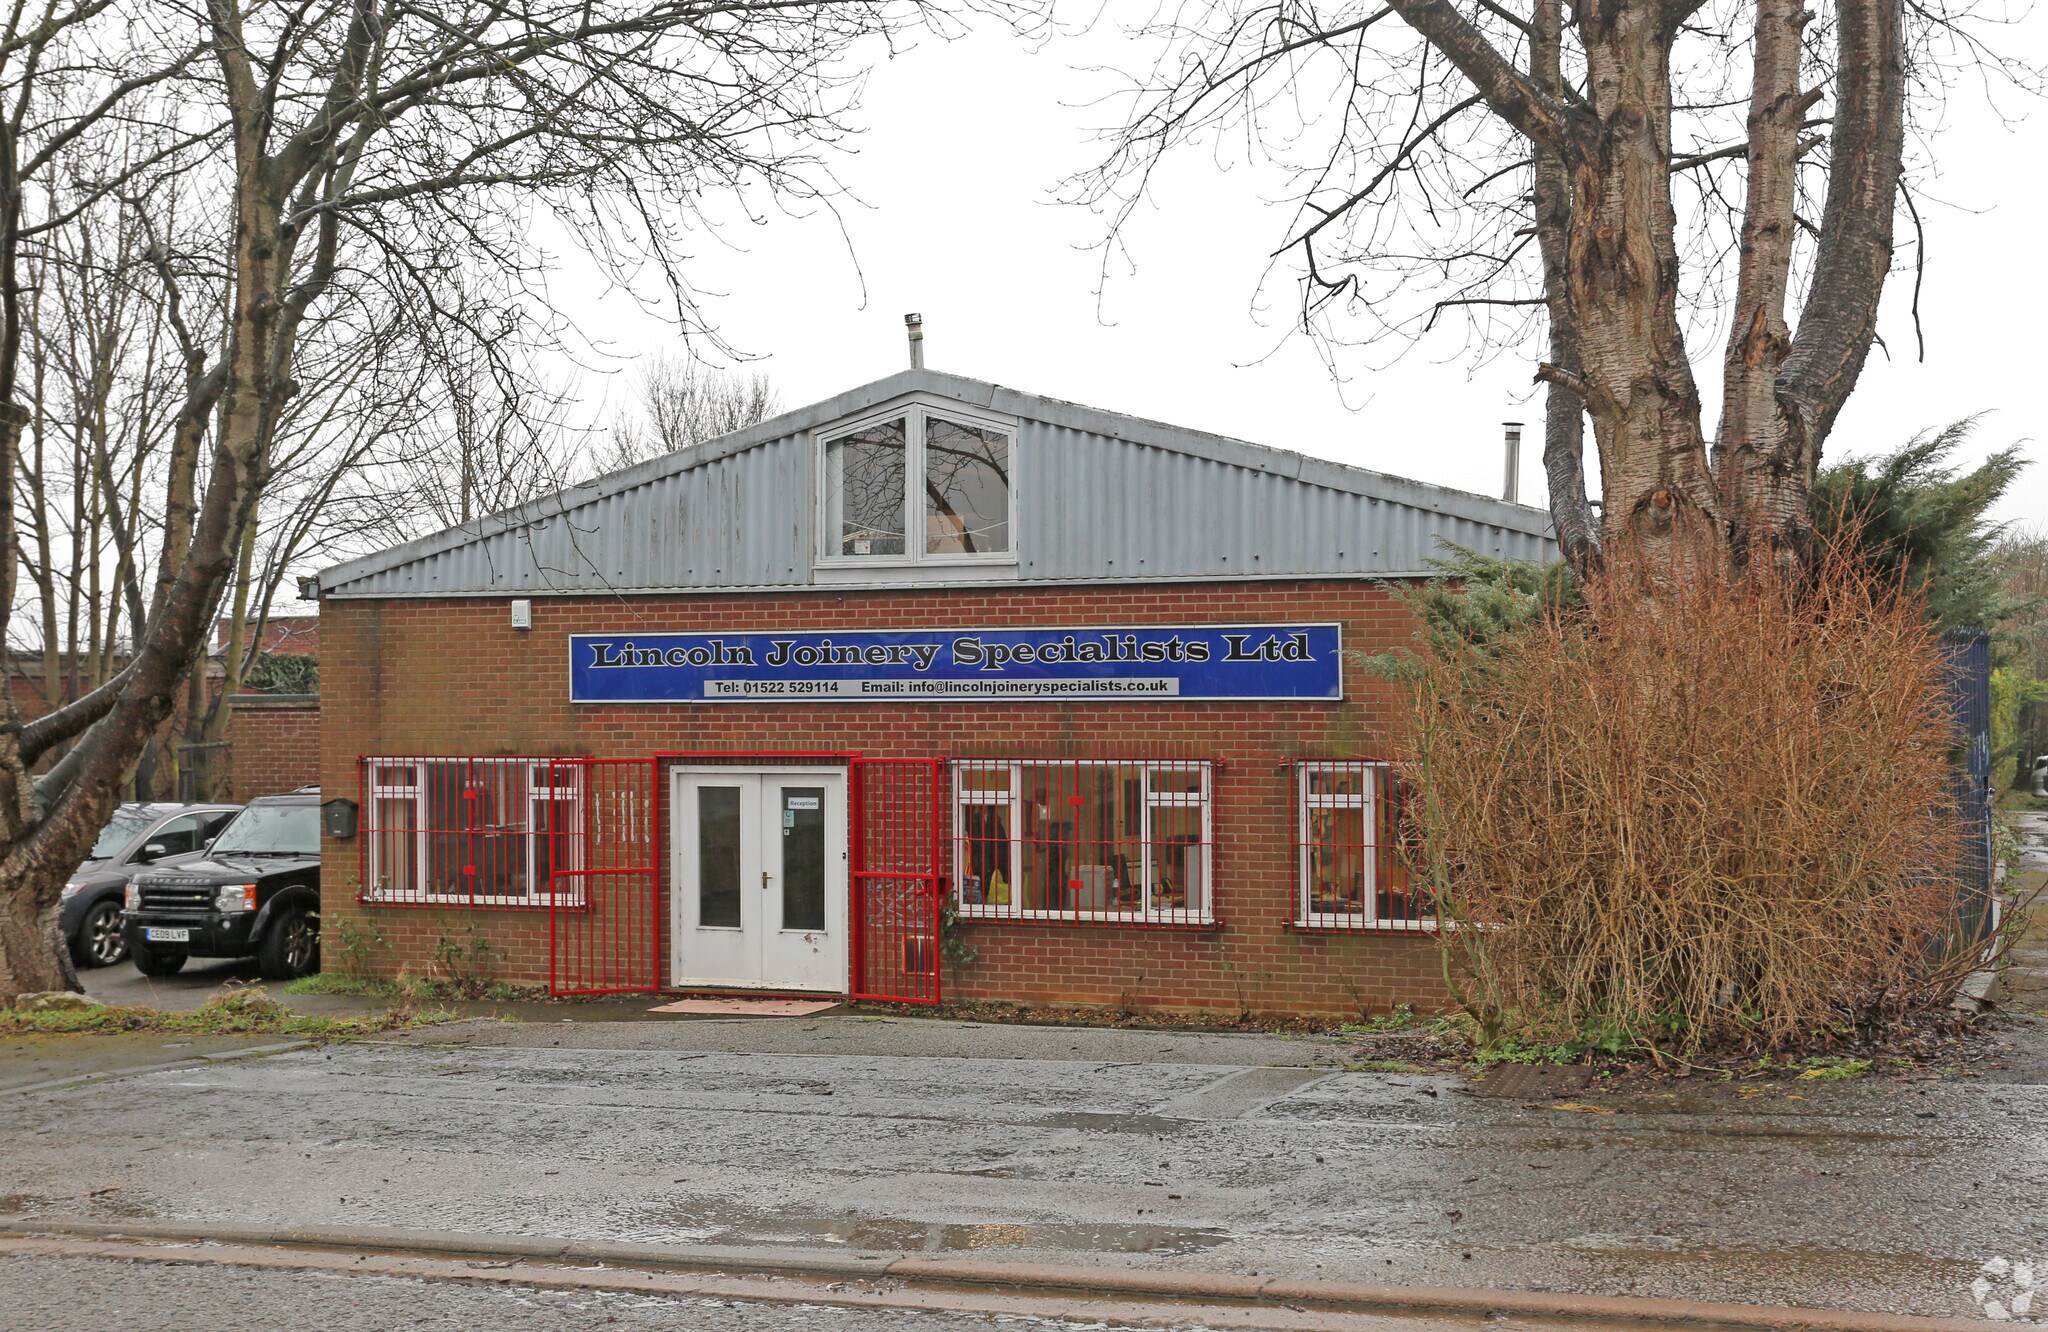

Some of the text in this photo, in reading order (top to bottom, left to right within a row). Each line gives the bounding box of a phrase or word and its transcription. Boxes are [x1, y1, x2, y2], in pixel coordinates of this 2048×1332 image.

[588, 633, 1316, 671] Lincoln Joinery Specialists Ltd
[715, 679, 1168, 695] Tel: 01522 529114 Email: info@lincolnjoineryspecialists.co.uk
[151, 930, 187, 940] CE09 LVF
